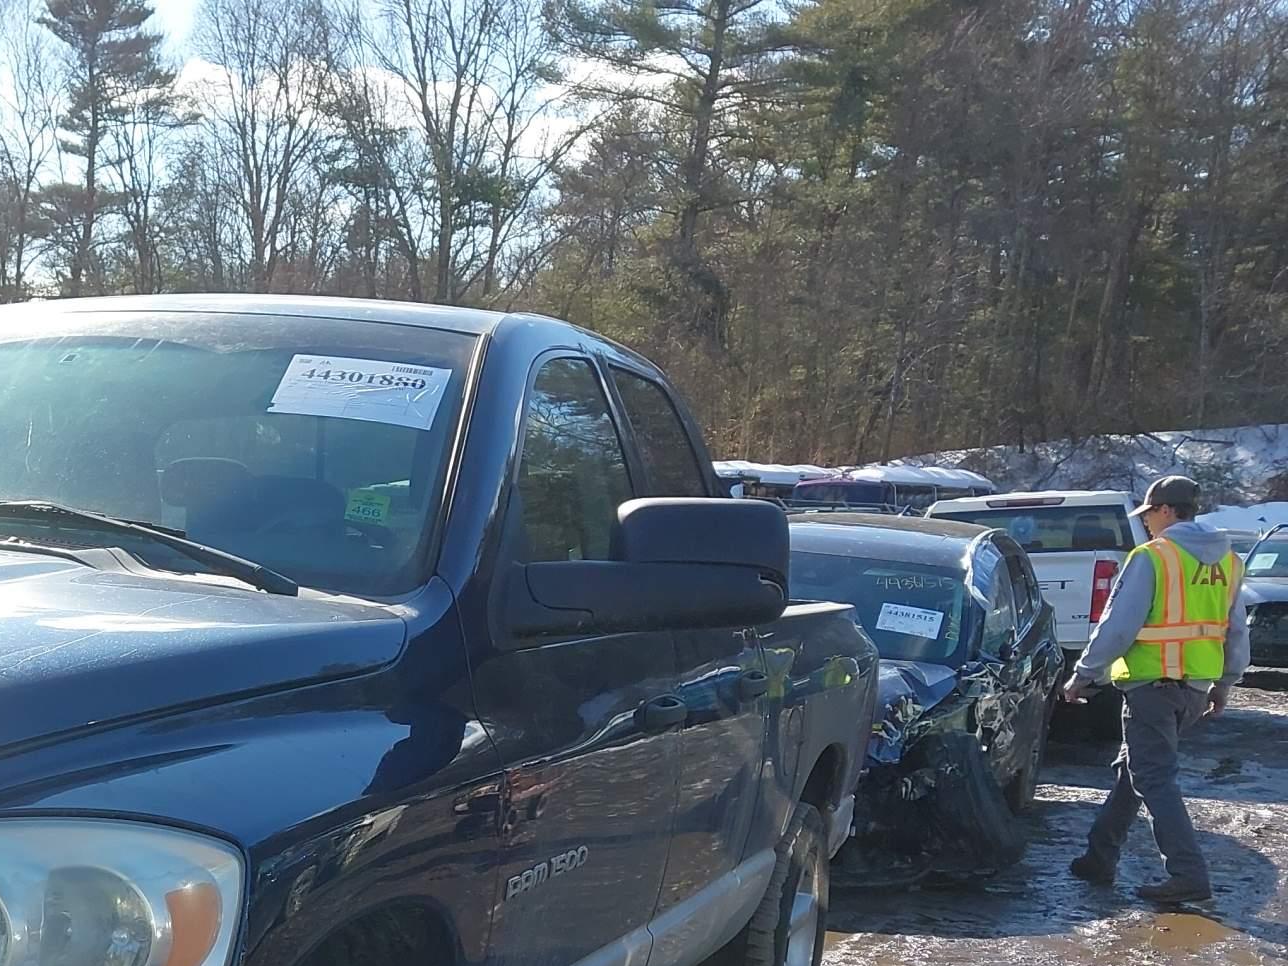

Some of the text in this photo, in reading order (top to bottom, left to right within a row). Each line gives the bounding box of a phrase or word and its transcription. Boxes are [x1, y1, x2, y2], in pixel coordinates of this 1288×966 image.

[301, 367, 427, 389] 44301880
[351, 505, 381, 518] 466
[506, 845, 589, 901] RAM 1500
